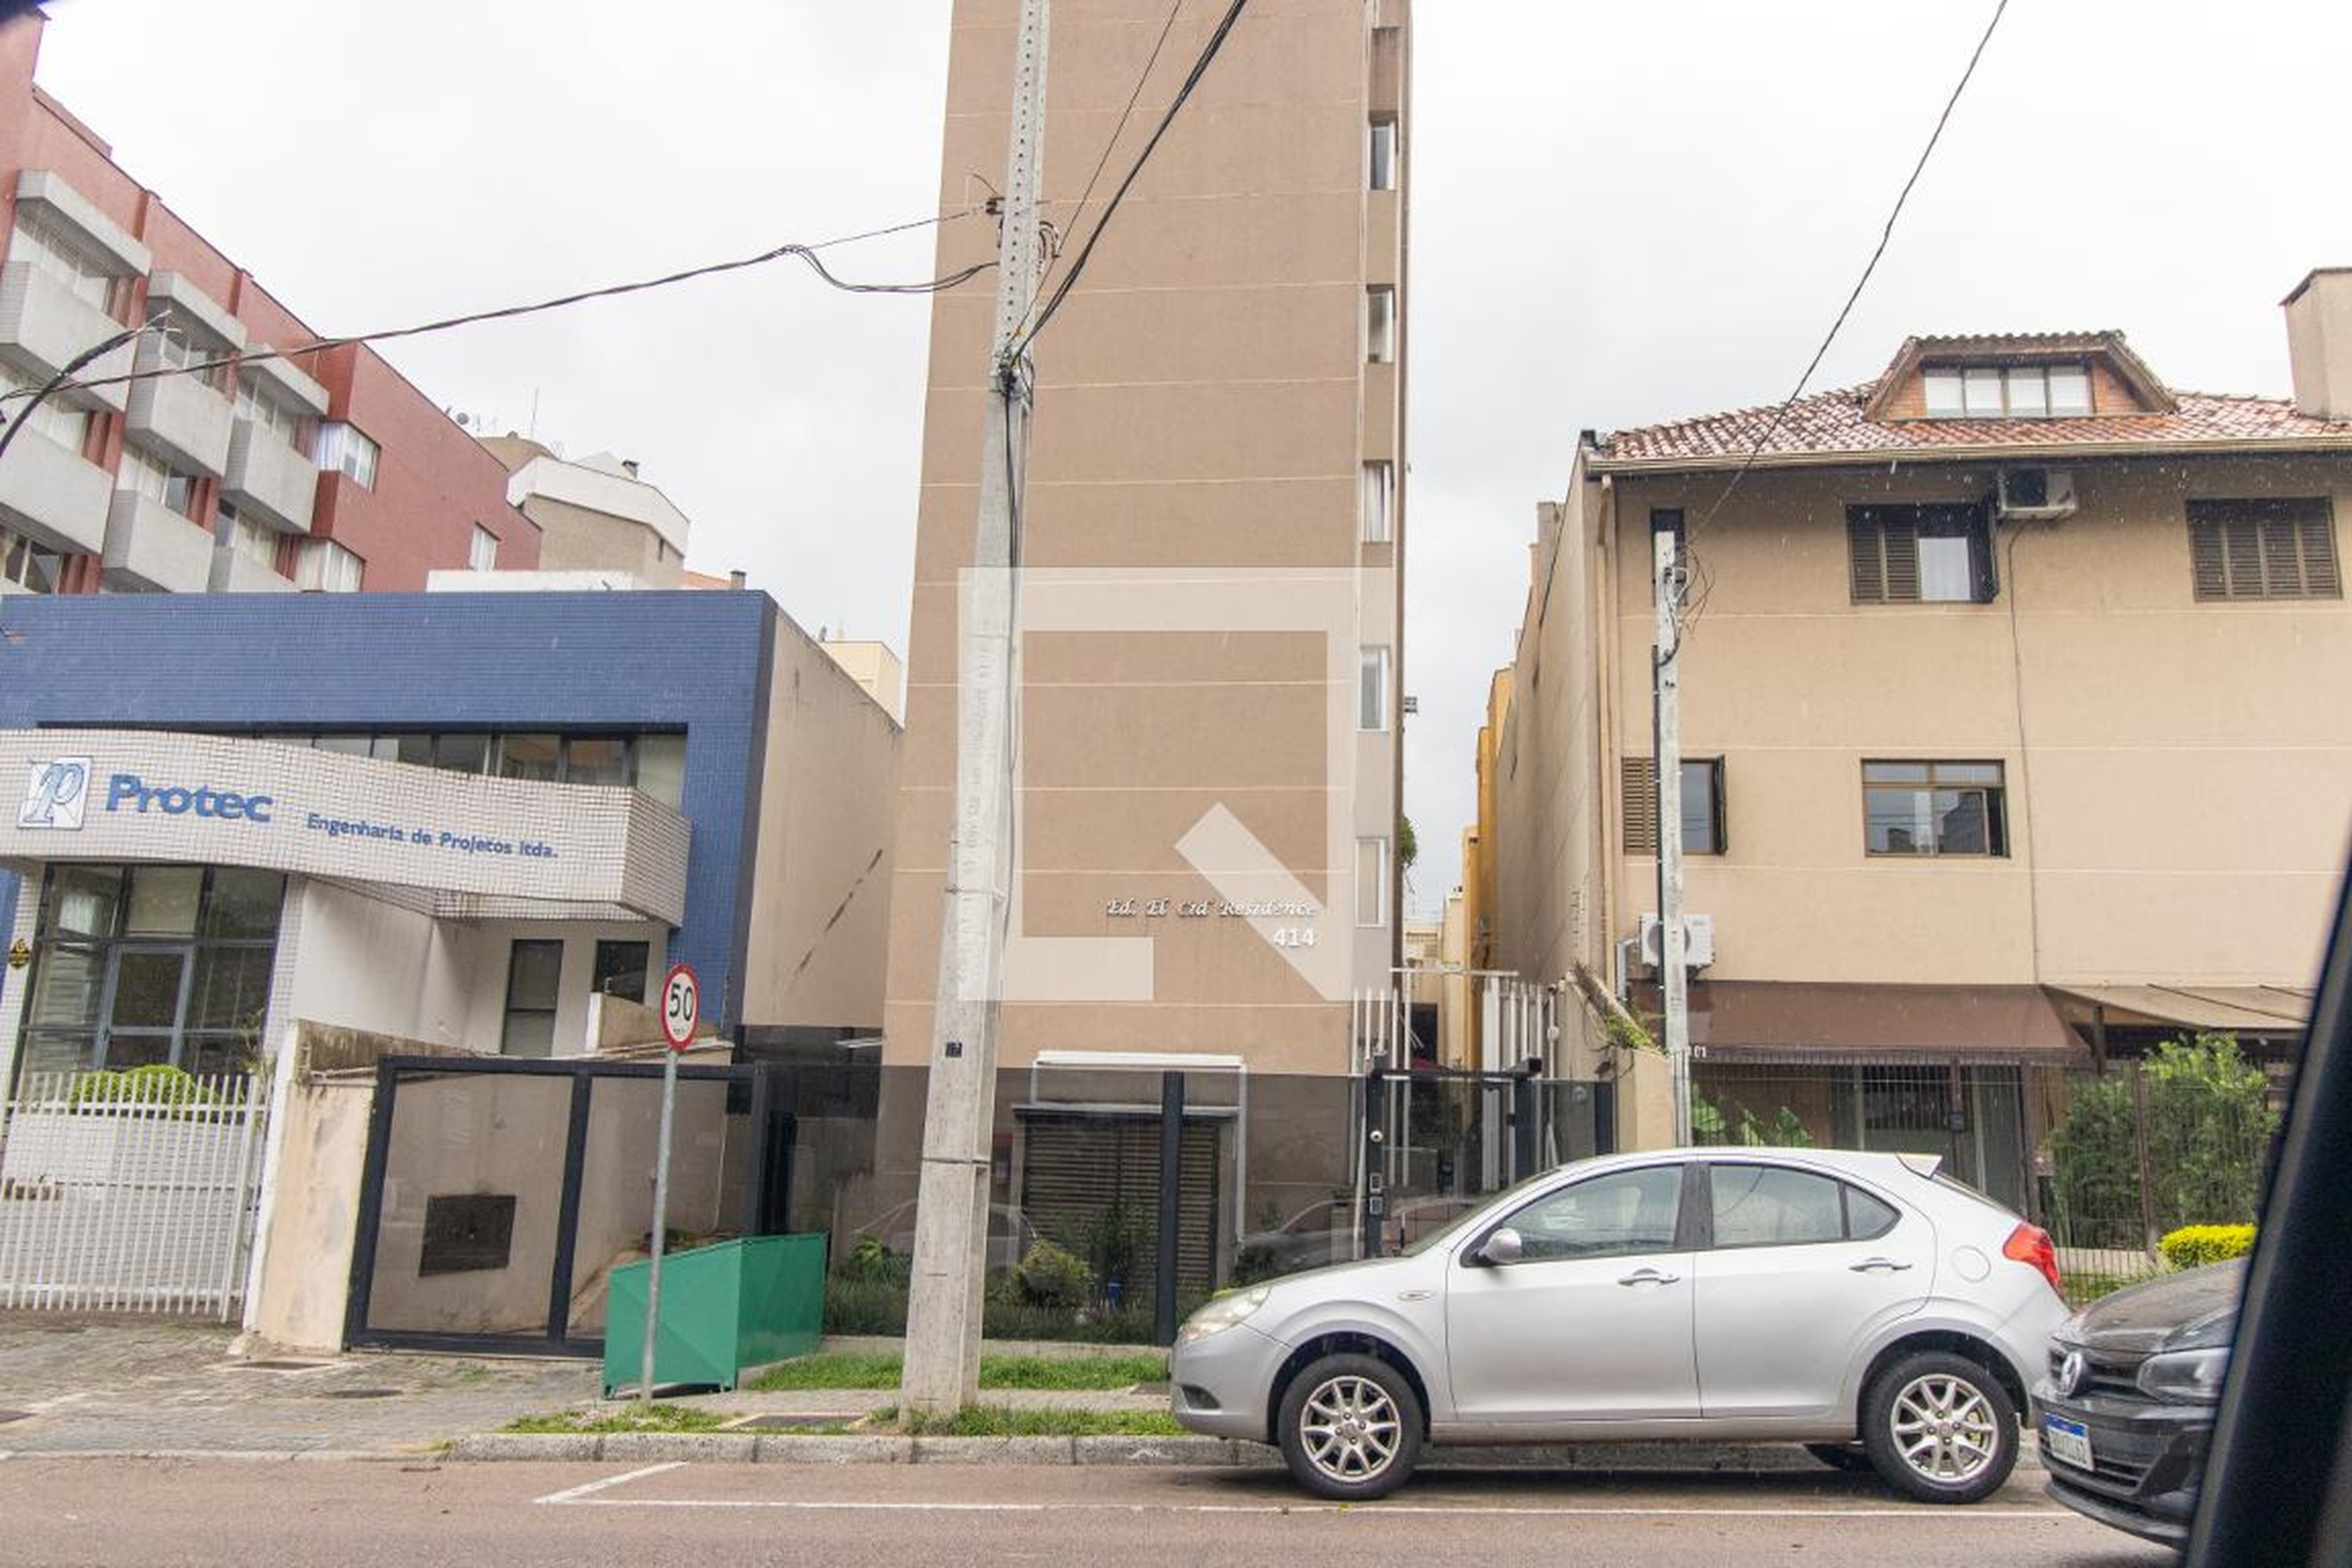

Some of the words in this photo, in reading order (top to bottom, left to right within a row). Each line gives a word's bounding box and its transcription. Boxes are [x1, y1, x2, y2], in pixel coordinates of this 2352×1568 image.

[105, 773, 274, 823] Protec
[307, 812, 404, 842] Engenharia
[412, 828, 432, 846] de
[440, 832, 513, 855] Projetos
[1107, 897, 1137, 917] Ed.
[1146, 897, 1169, 916] El
[1218, 899, 1317, 917] Residence
[1273, 927, 1315, 947] 414
[669, 983, 694, 1021] 50
